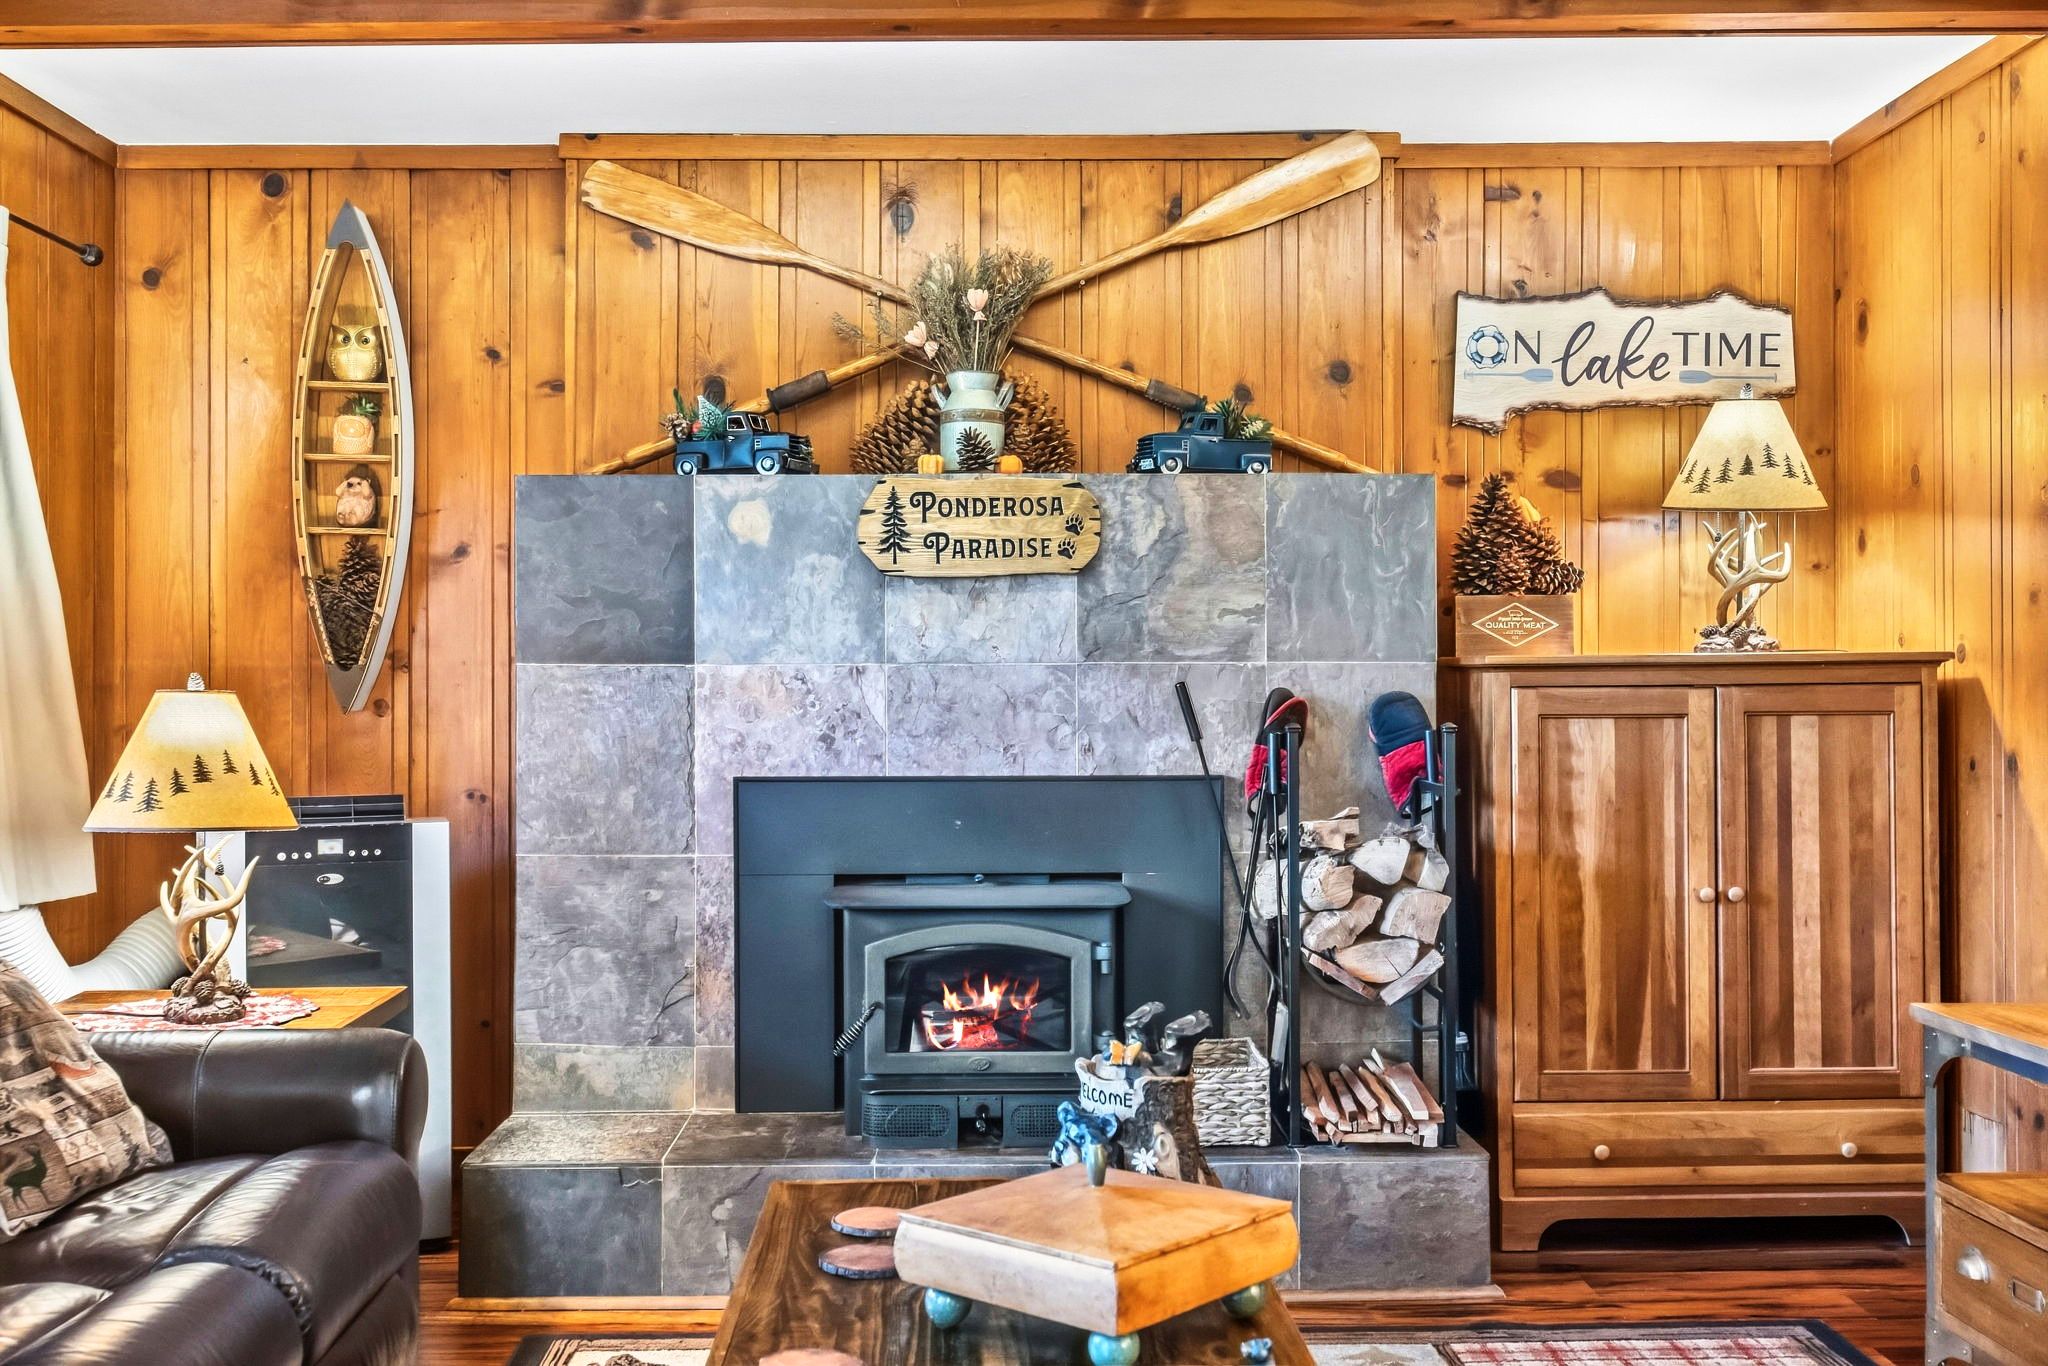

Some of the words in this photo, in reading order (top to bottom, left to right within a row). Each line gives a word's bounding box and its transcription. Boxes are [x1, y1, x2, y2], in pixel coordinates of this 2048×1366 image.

[1551, 316, 1671, 389] lake
[1672, 332, 1781, 368] TIME
[909, 491, 1065, 523] PONDEROSA
[923, 531, 1053, 564] PARADISE
[1081, 1082, 1133, 1108] ELCOME
